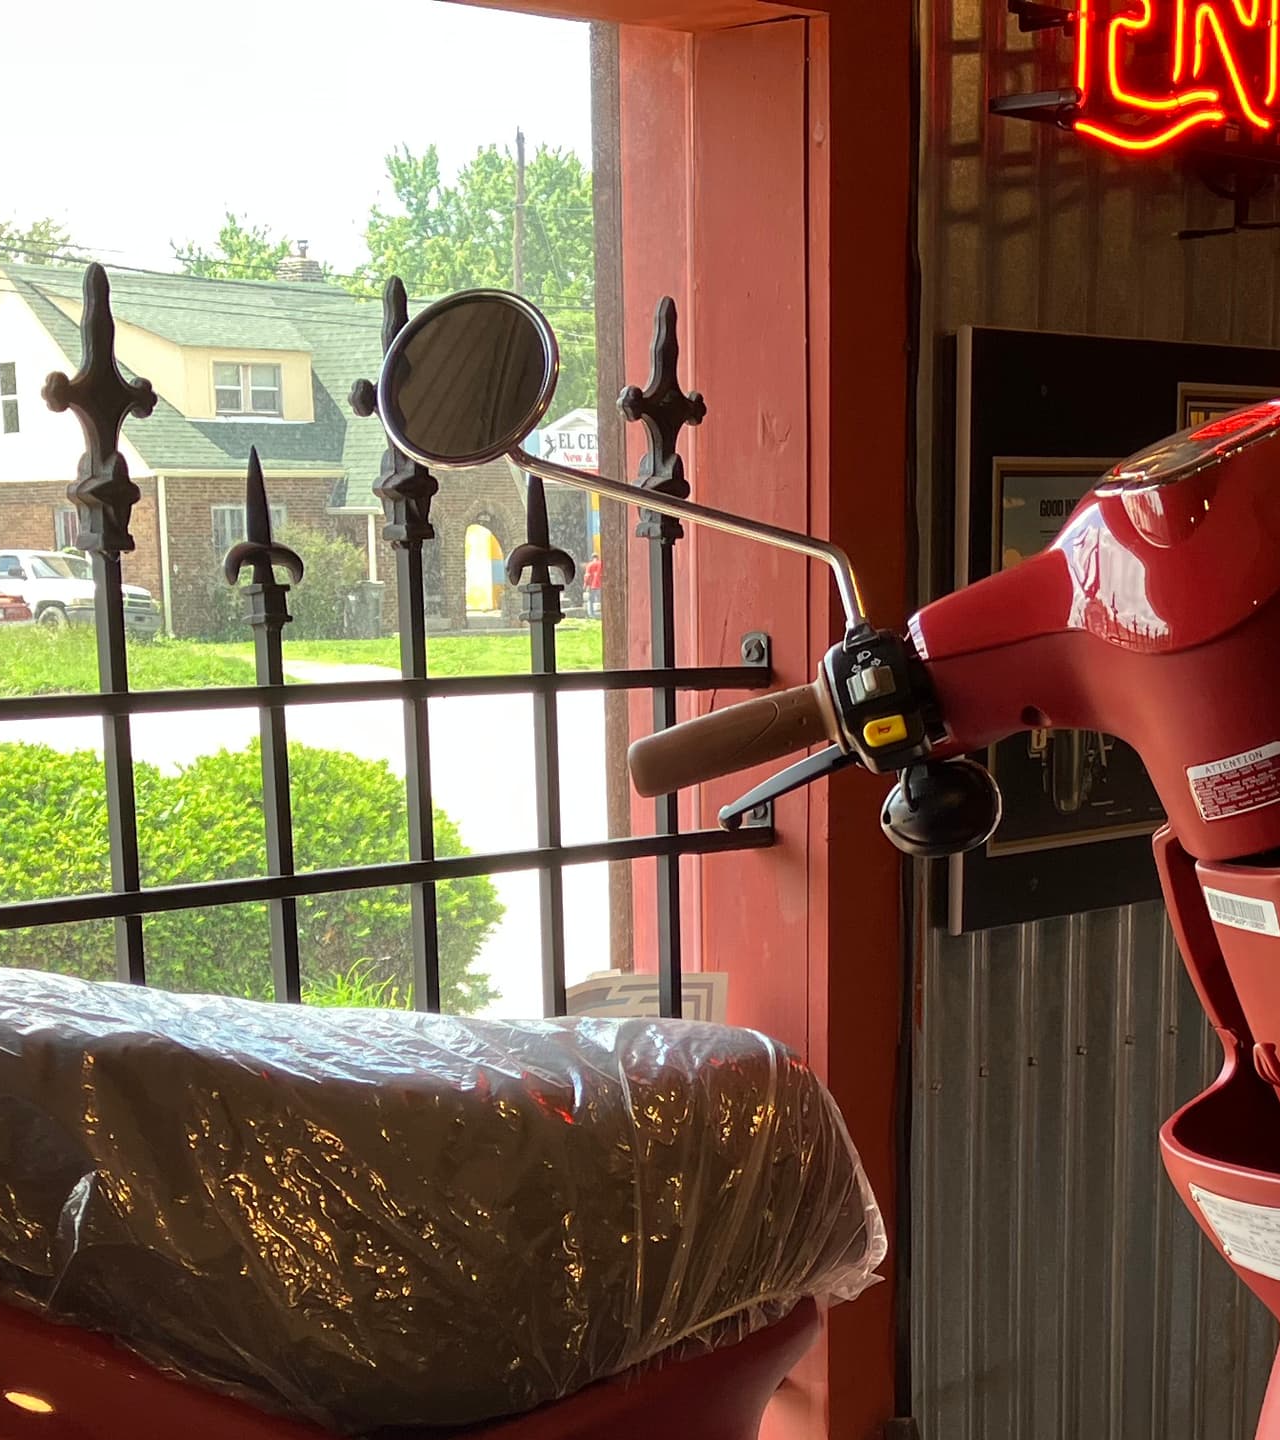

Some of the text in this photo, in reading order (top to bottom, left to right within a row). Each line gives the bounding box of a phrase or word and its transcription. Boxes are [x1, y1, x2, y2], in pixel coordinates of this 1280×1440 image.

[559, 433, 576, 449] EL
[1040, 499, 1064, 517] GOOD
[1205, 751, 1263, 774] ATTENTION
